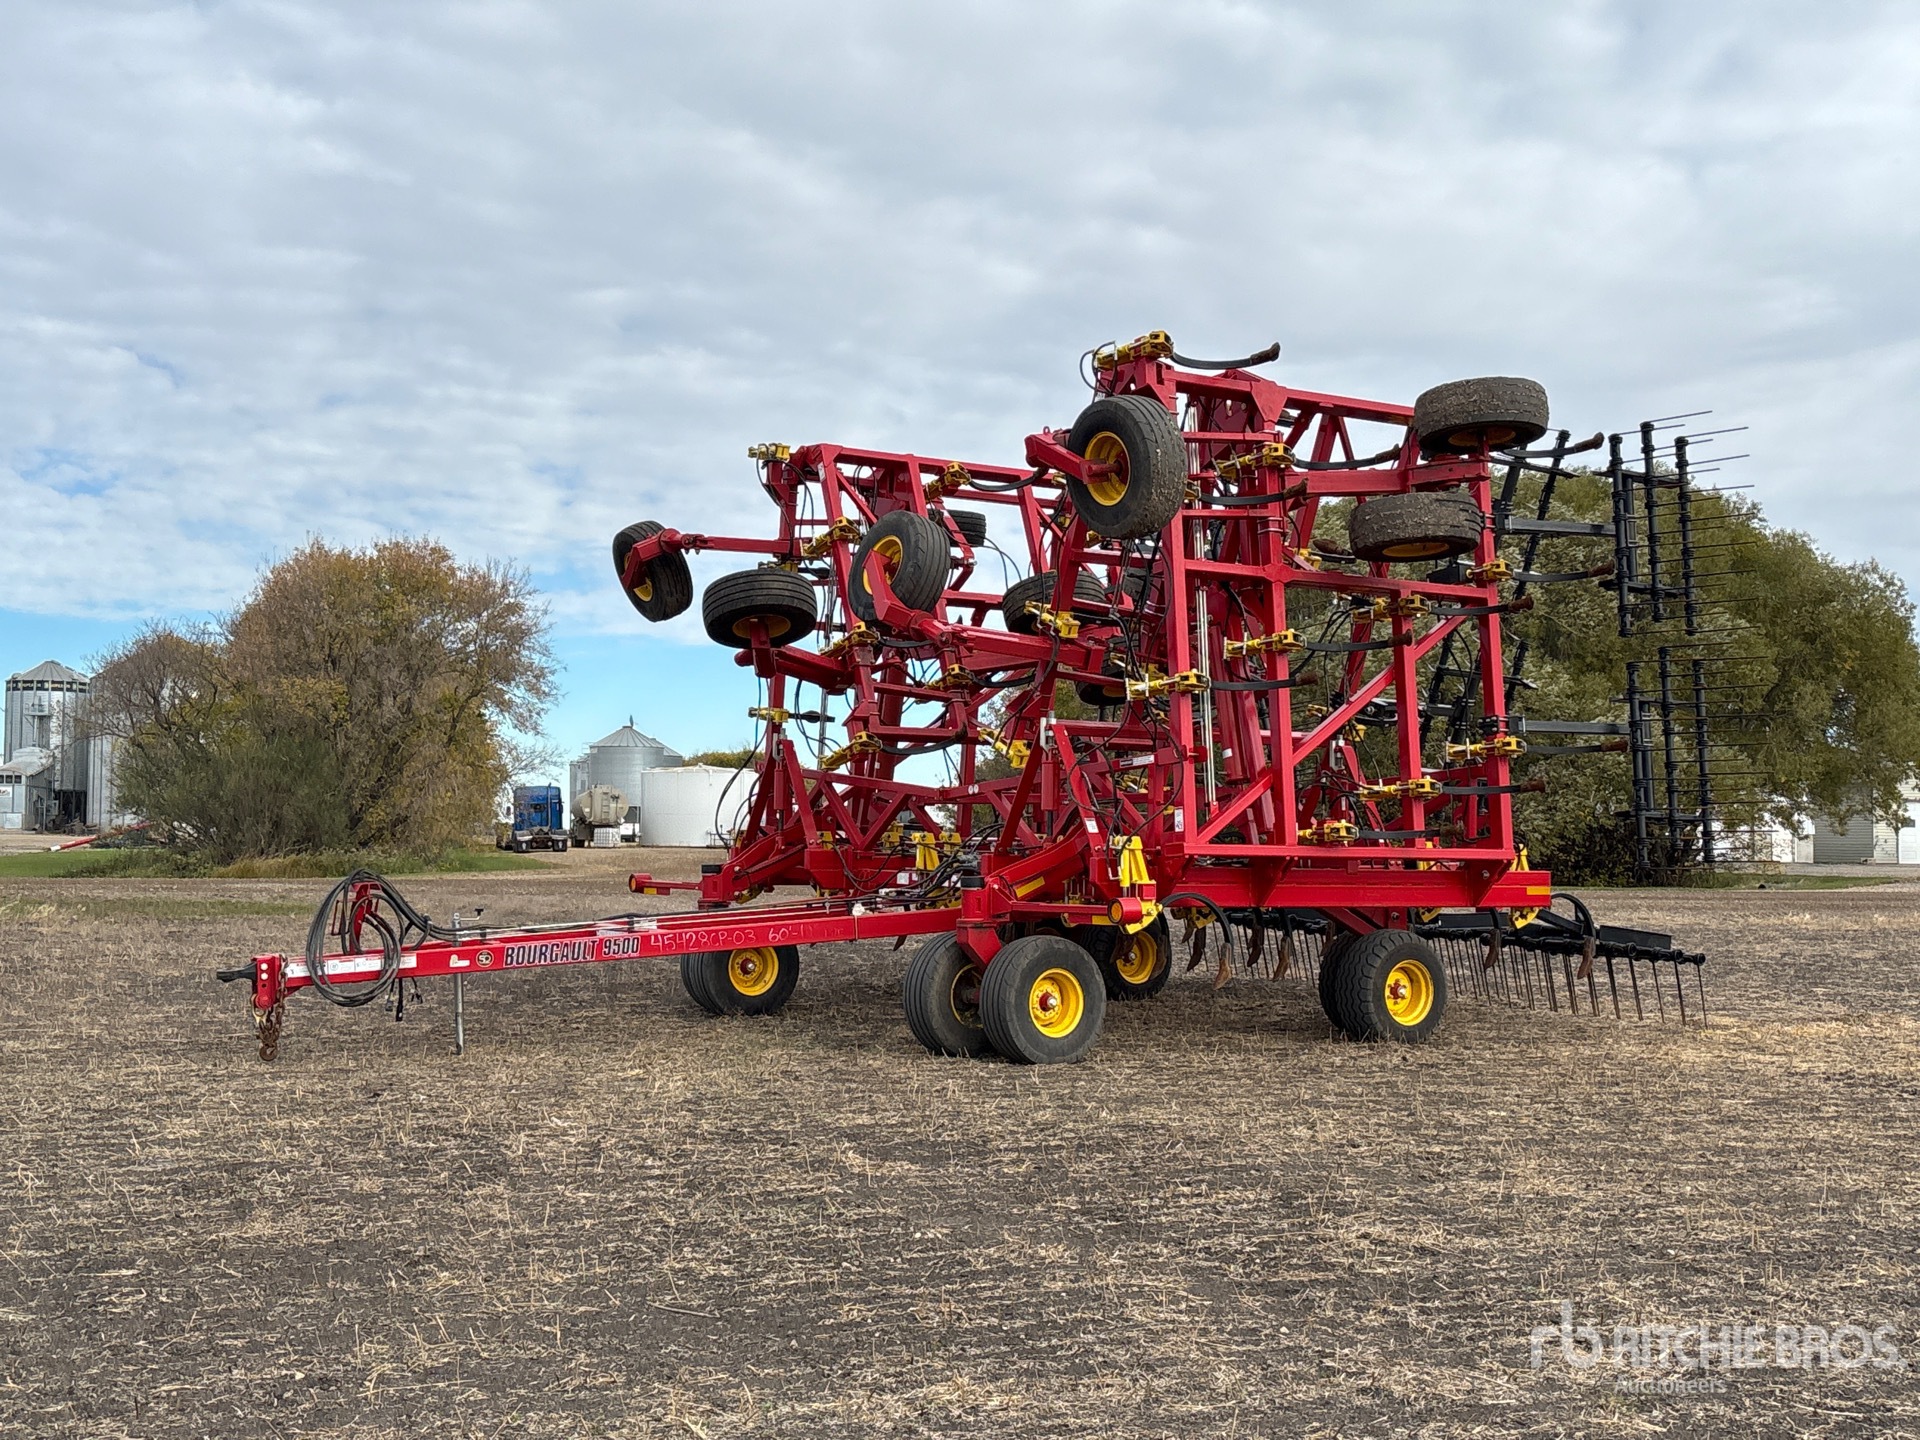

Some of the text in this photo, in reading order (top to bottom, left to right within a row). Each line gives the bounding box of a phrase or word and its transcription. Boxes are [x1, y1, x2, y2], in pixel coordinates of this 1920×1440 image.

[503, 935, 641, 967] BOURGAULT 9500
[650, 929, 756, 953] 45428CP-03
